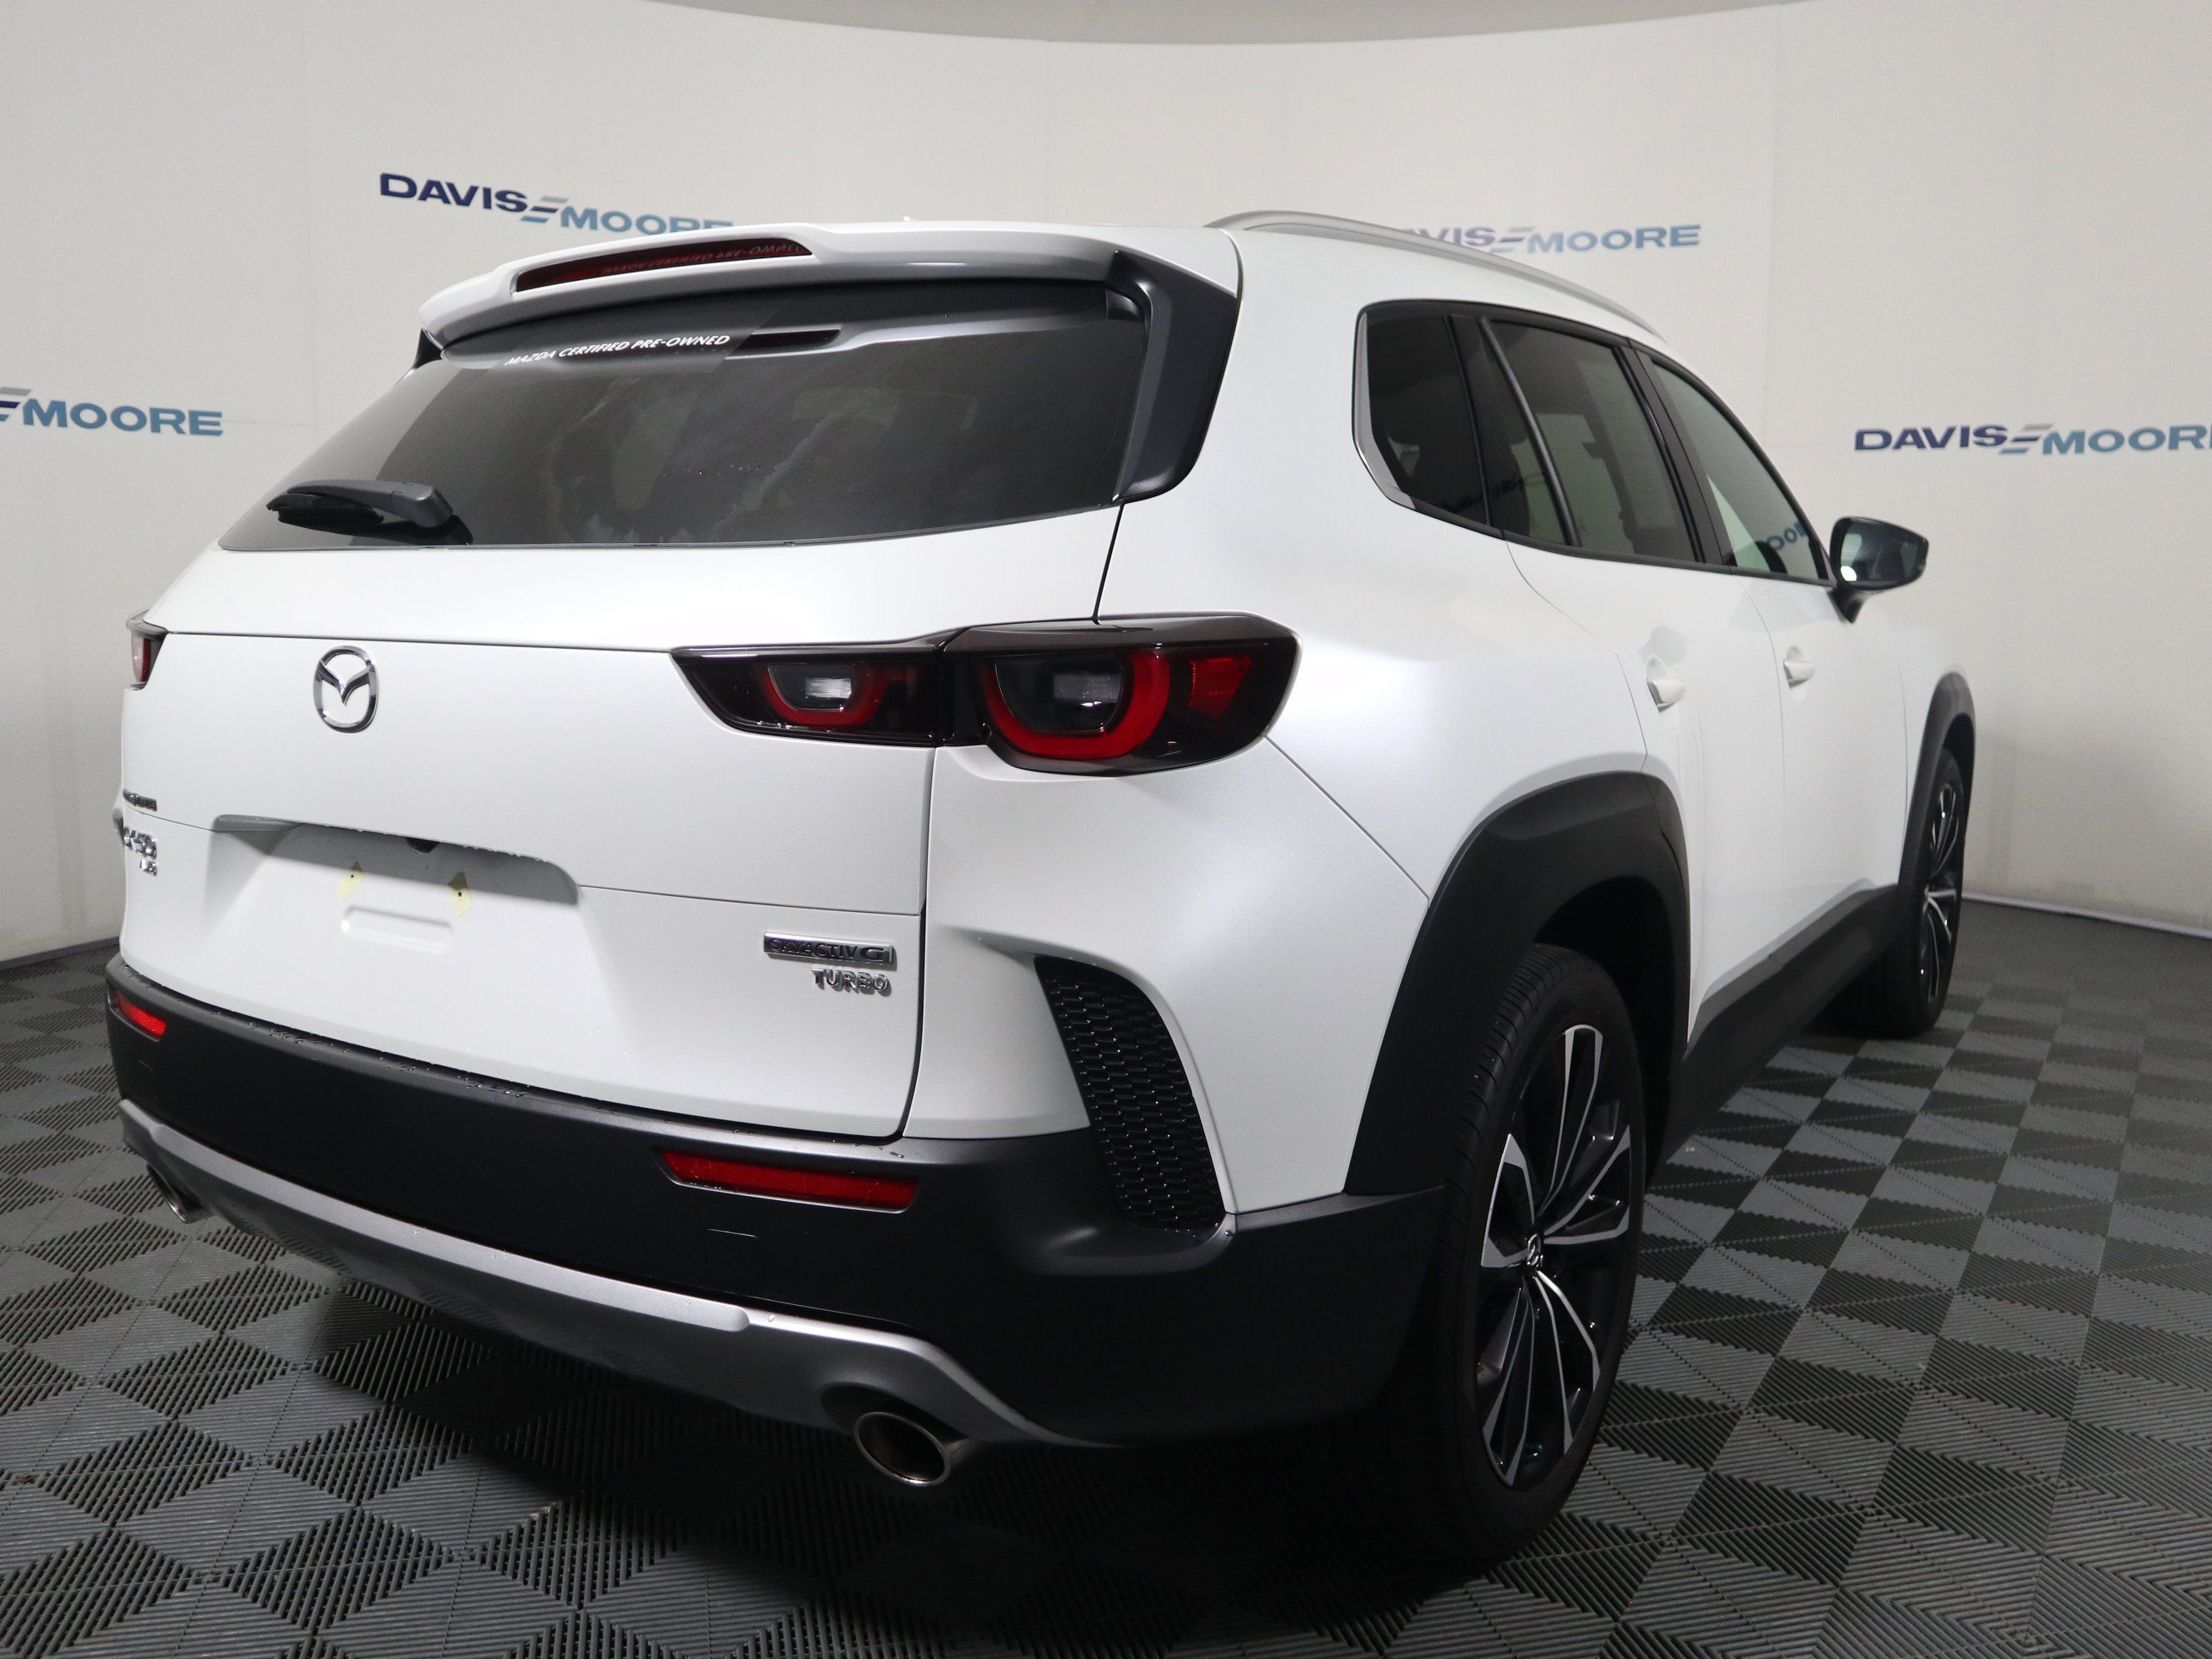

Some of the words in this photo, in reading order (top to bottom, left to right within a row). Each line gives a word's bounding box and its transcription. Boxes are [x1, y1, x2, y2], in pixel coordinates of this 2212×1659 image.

[380, 172, 528, 213] DAVIS
[1401, 226, 1497, 247] VIS
[1526, 224, 1701, 254] MOORE
[504, 350, 555, 366] MAZDA
[558, 341, 630, 358] CERTIFIED
[630, 335, 731, 351] PRE-OWNED
[22, 397, 223, 436] MOORE
[1854, 425, 2009, 451] DAVIS
[2042, 425, 2212, 456] MOOR
[810, 967, 889, 993] TURBO
